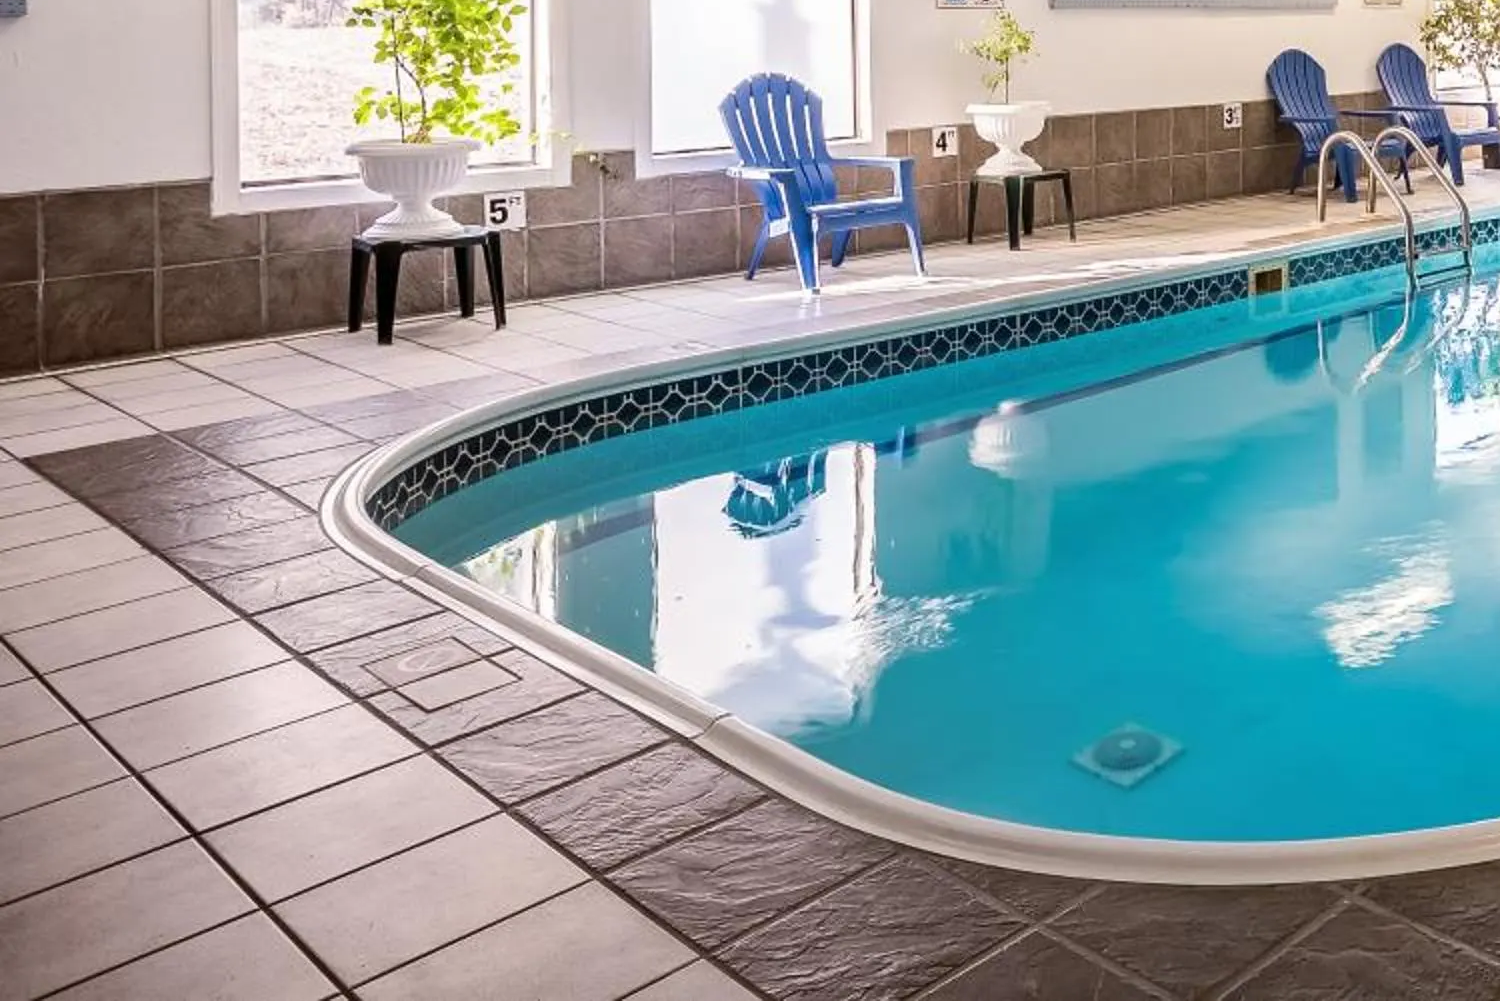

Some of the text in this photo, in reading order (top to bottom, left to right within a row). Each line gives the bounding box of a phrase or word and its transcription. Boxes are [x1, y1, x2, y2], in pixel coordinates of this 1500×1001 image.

[1225, 107, 1234, 125] 3
[936, 131, 948, 152] 4
[489, 198, 509, 225] 5
